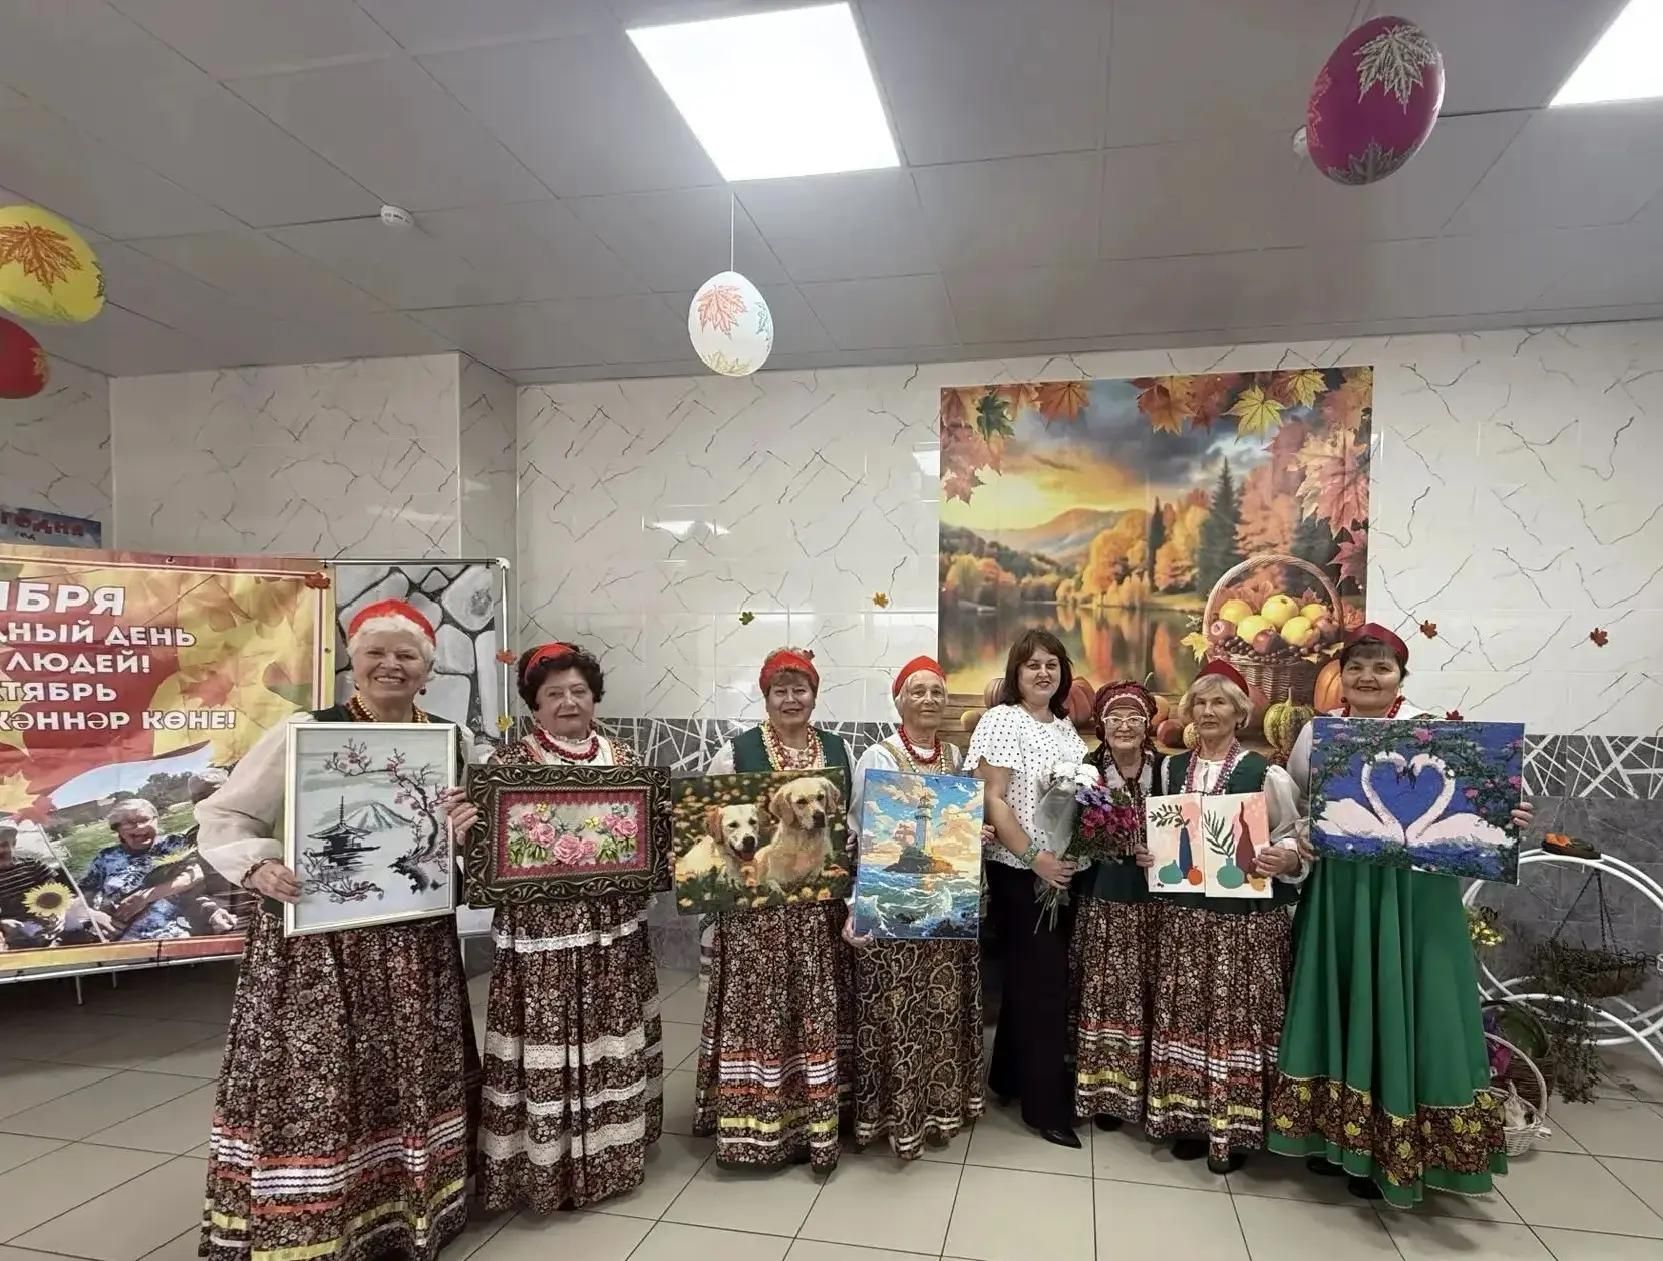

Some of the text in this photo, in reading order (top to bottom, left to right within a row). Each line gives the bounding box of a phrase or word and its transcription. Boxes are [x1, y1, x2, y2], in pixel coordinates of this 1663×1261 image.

[0, 619, 197, 647] НЫЙ ДЕНЬ
[6, 649, 152, 674] ЛЮДЕЙ!
[0, 681, 118, 702] ТЯБРЬ
[141, 710, 237, 730] КӨНЕ!
